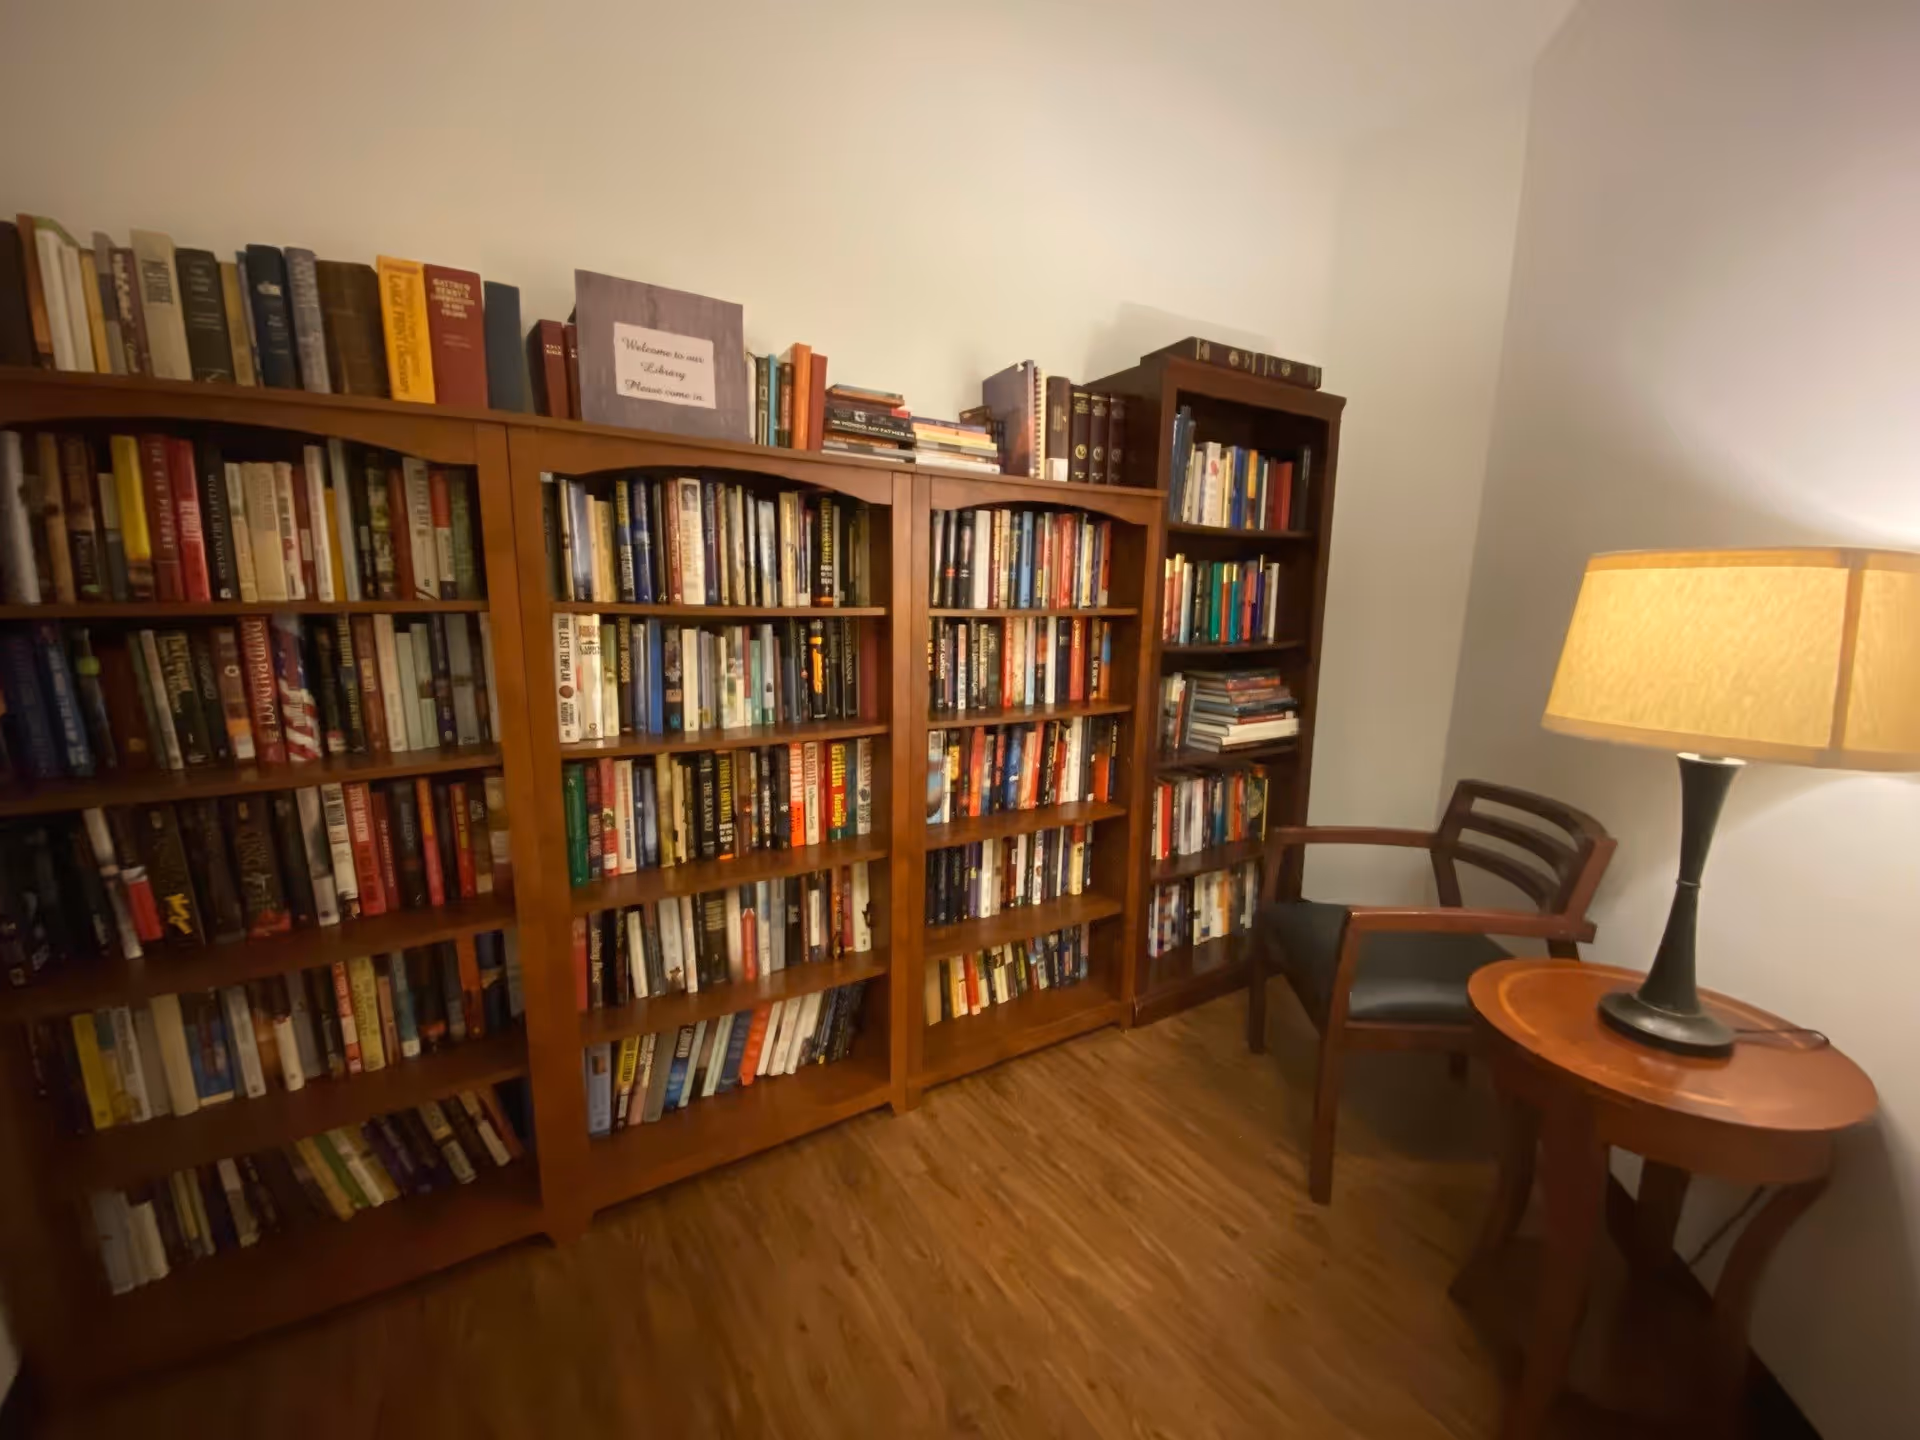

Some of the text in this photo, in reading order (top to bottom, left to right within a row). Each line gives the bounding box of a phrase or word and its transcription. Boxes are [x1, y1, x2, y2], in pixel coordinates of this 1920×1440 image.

[621, 337, 705, 364] Welcome to our
[624, 378, 662, 395] Please
[664, 388, 690, 399] come
[640, 361, 686, 381] Library
[558, 617, 572, 683] THE LAST TEMPLAR
[239, 620, 276, 725] DAVID BALDACCI
[831, 743, 847, 788] Griffin
[832, 792, 845, 827] Hostage
